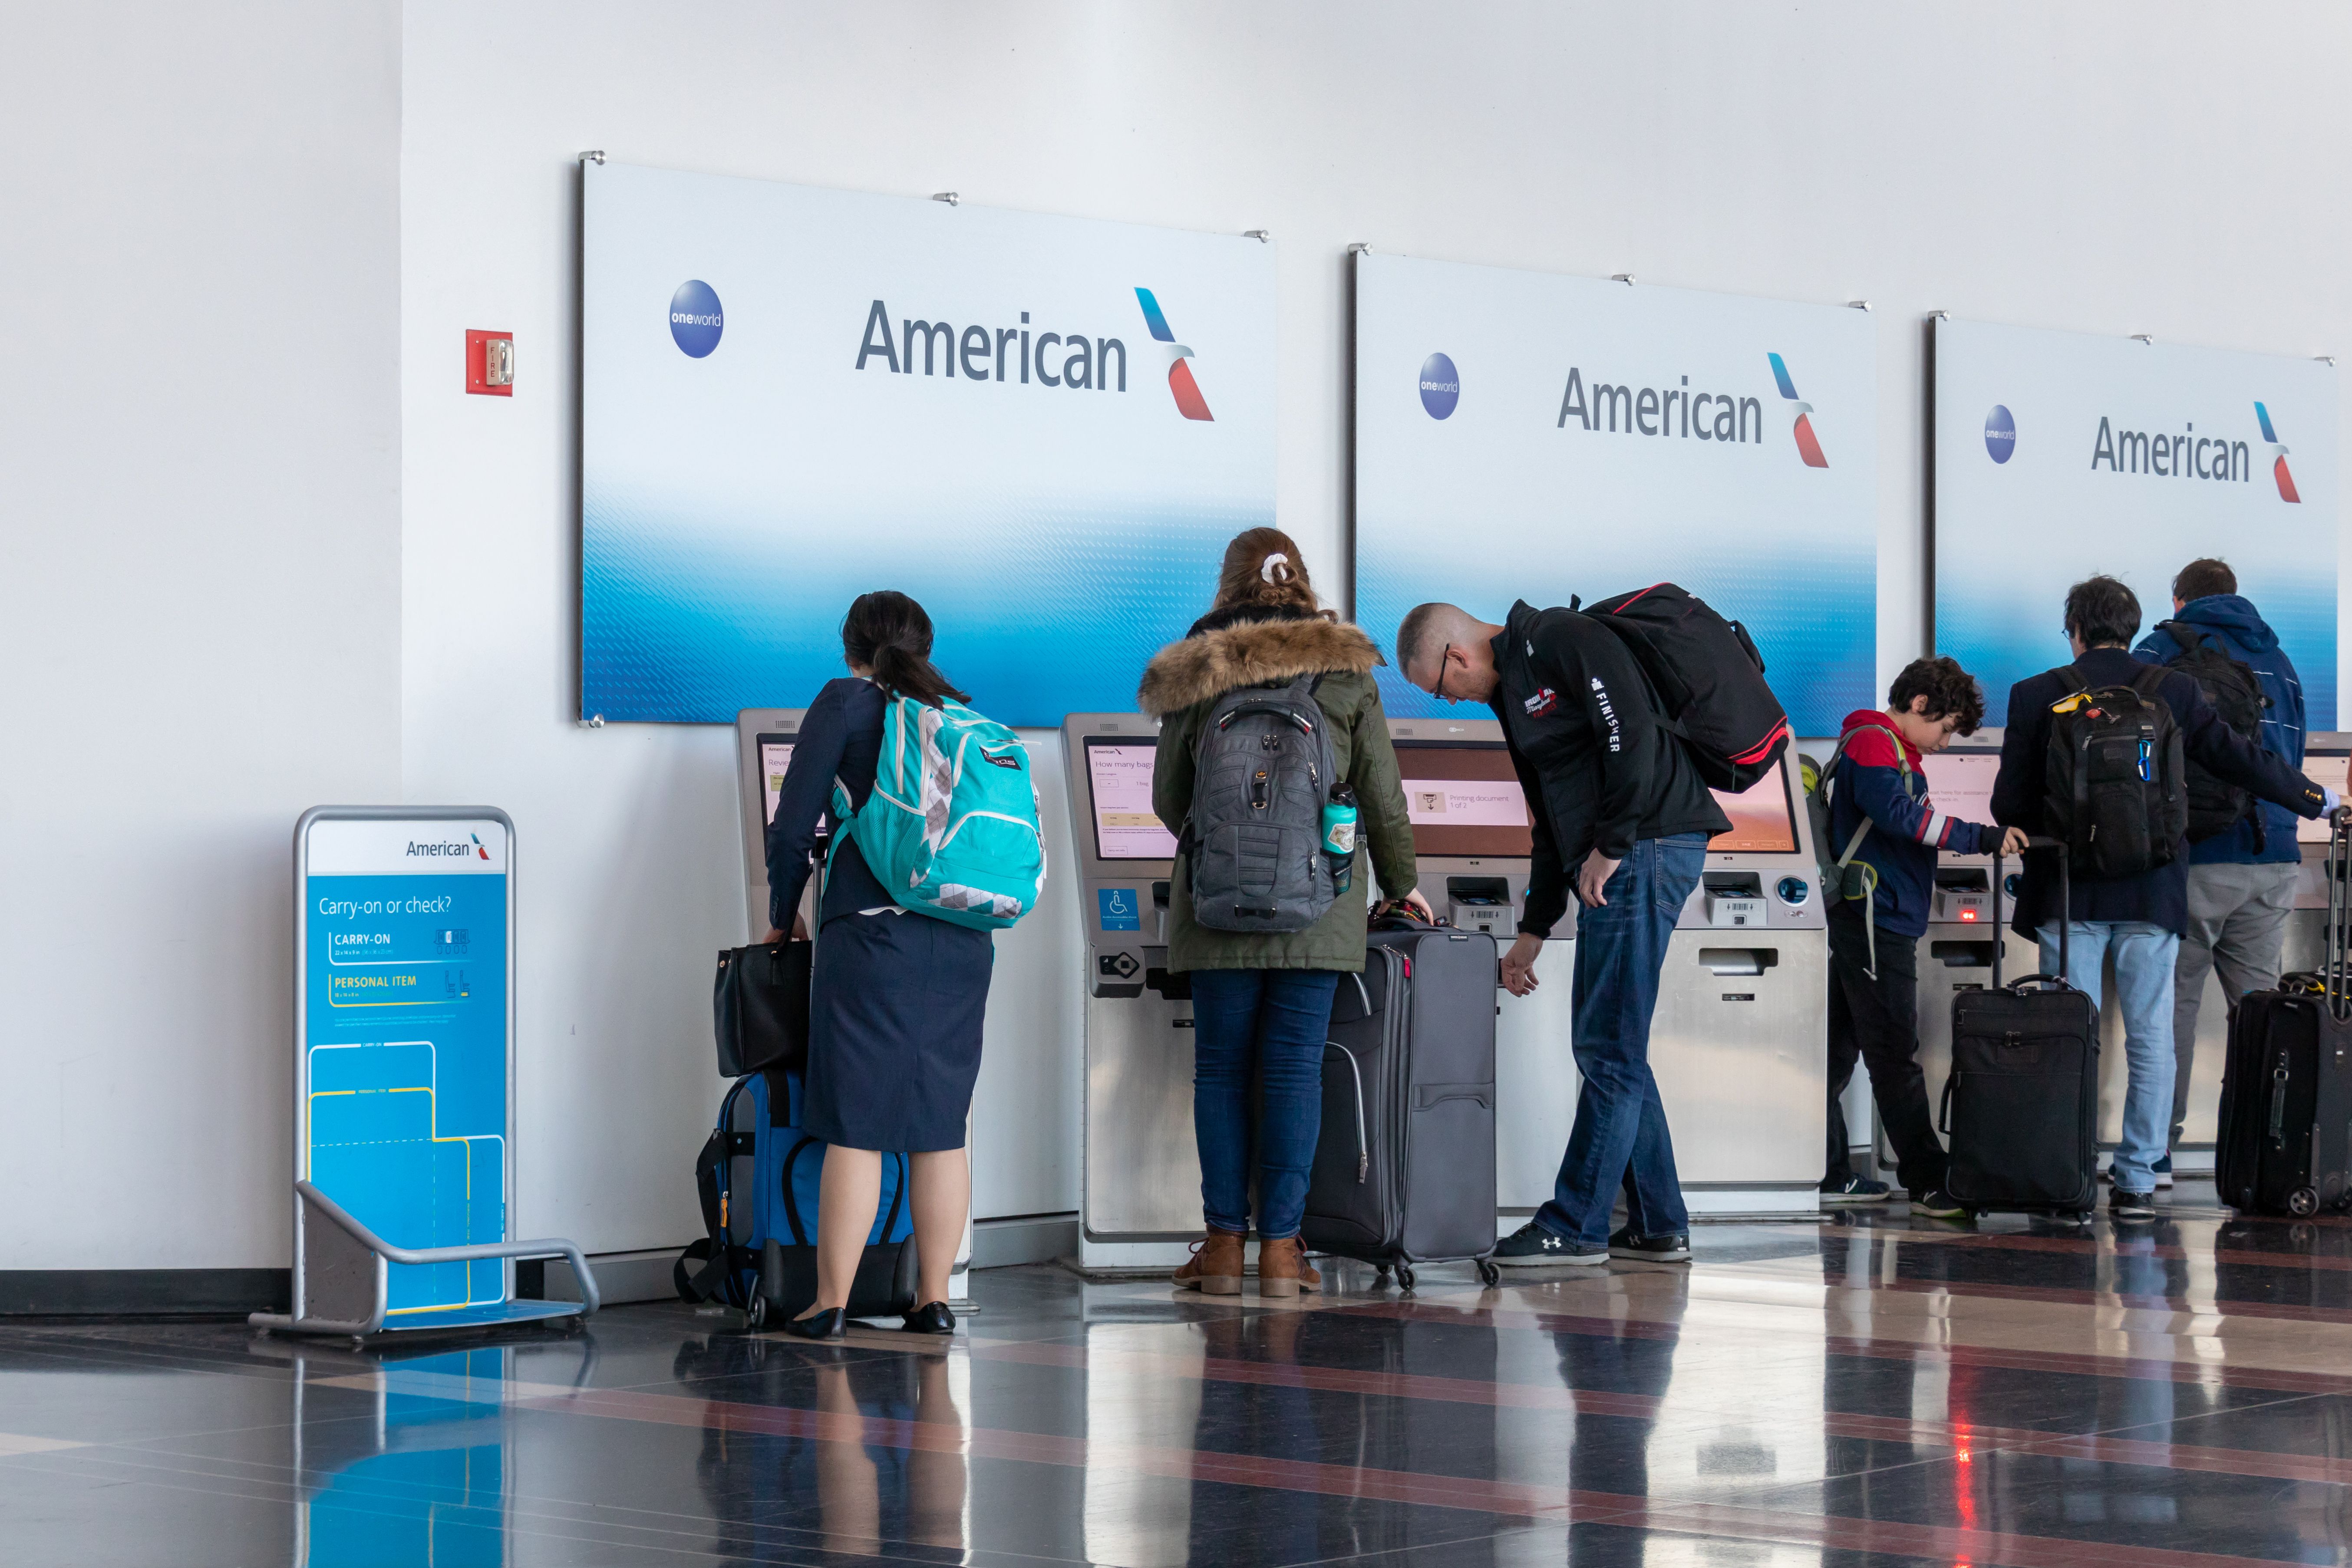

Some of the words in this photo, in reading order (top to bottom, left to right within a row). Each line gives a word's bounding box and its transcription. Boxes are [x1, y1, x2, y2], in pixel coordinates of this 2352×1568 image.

[672, 313, 721, 327] oneworld
[855, 299, 1126, 393] American
[1421, 381, 1458, 393] oneworld
[1557, 367, 1762, 444] American
[1986, 430, 2015, 440] oneworld
[2091, 416, 2249, 482] American
[1596, 693, 1620, 752] FINISHER
[1450, 795, 1475, 803] Printing
[406, 840, 469, 857] American
[319, 898, 382, 920] Carry-on
[386, 900, 402, 913] or
[406, 896, 452, 913] check?
[335, 934, 390, 945] CARRY-ON
[335, 977, 389, 988] PERSONAL
[393, 976, 416, 986] ITEM
